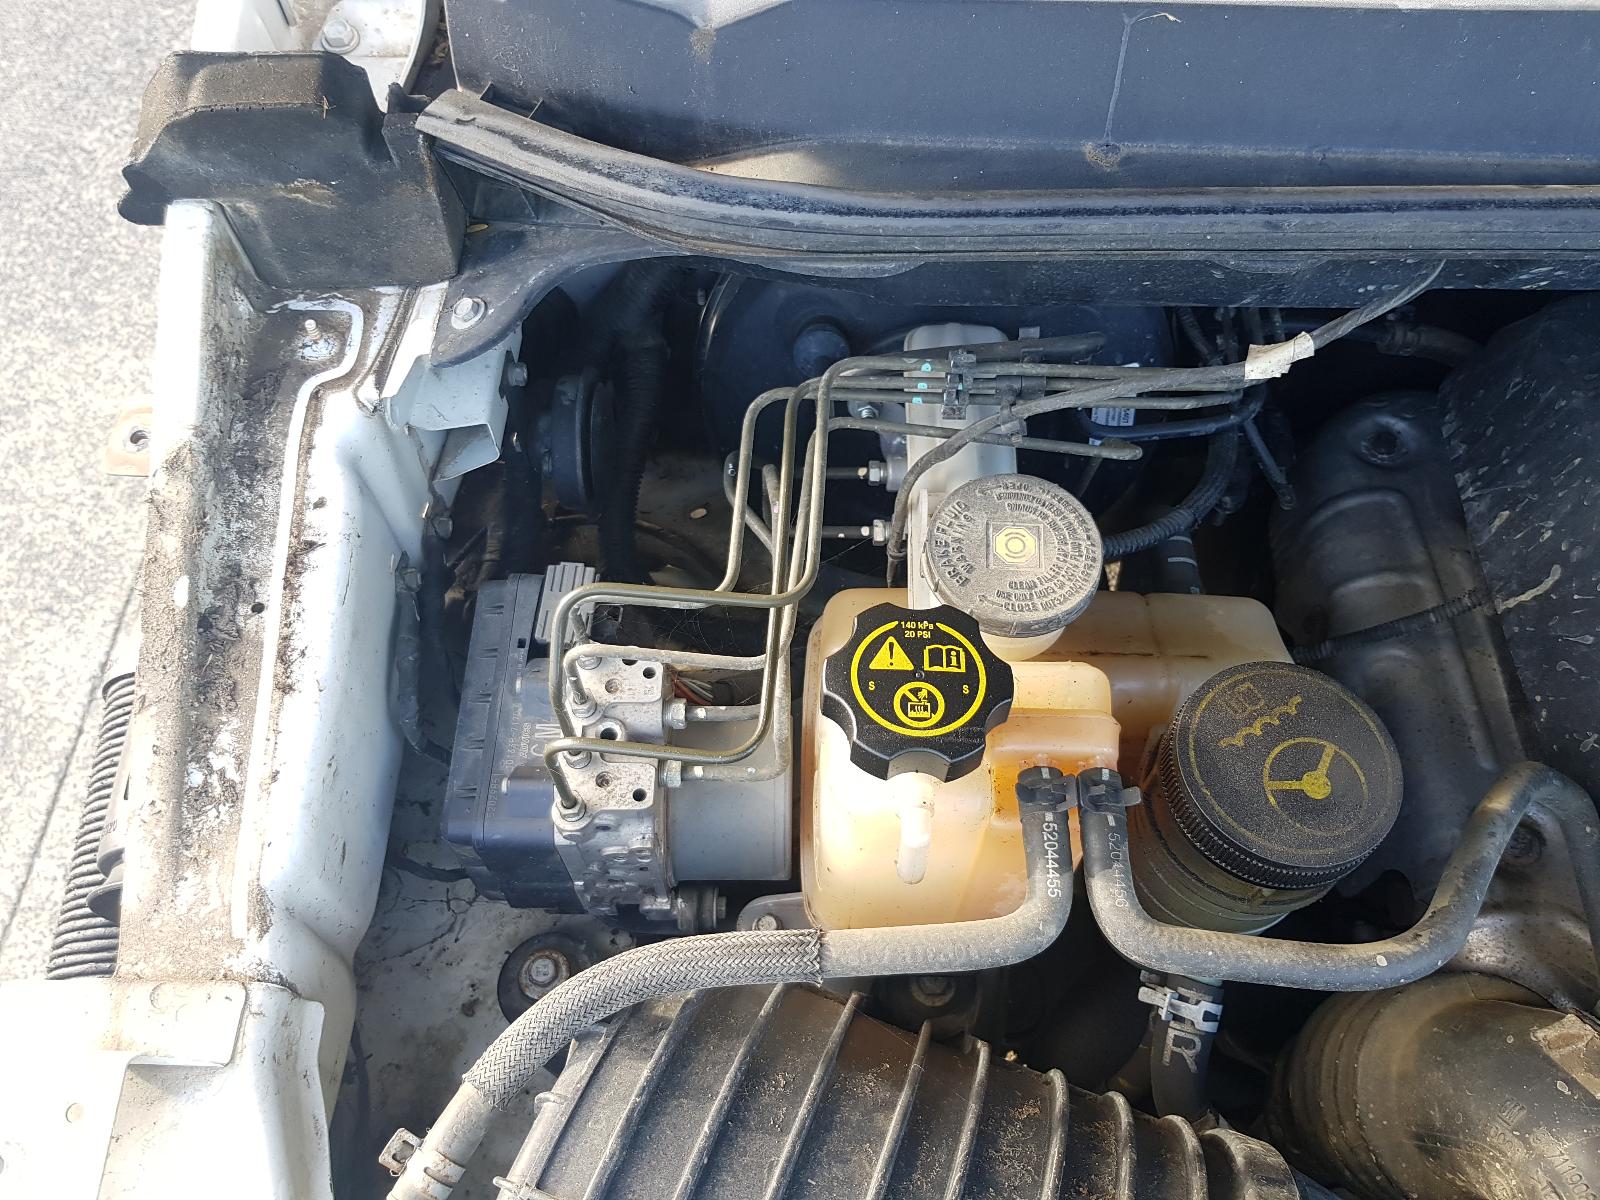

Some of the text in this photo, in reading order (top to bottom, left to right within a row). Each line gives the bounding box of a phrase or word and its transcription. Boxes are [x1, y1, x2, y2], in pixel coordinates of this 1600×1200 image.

[935, 500, 970, 587] BRAKE FLUID
[951, 513, 976, 574] WARNING
[901, 621, 934, 630] 140 kPa
[904, 630, 931, 639] 20 PSI
[1042, 822, 1062, 898] 52044455
[1107, 831, 1129, 908] 52044456
